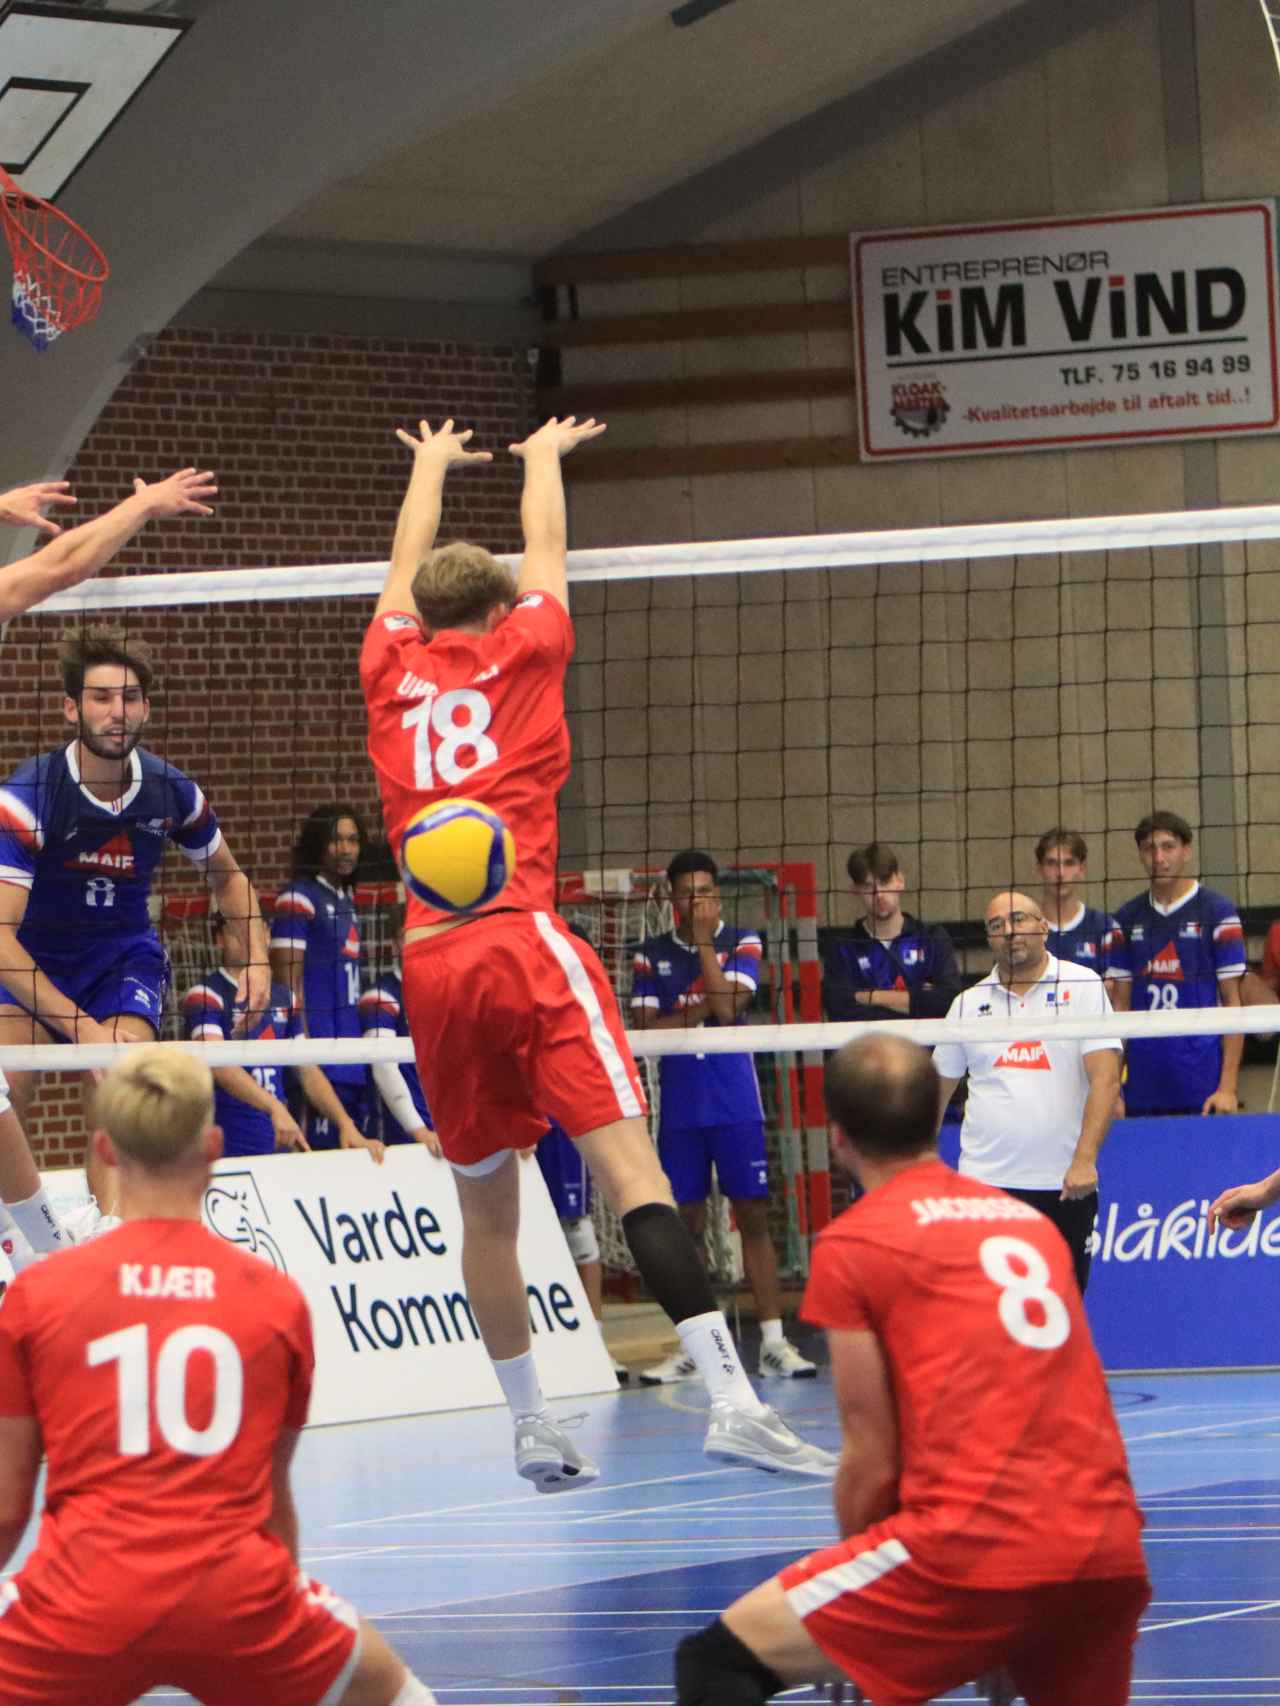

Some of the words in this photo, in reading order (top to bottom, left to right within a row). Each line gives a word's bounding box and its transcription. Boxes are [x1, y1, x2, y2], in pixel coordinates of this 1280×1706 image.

[882, 252, 1109, 287] ENTREPRENØR
[1060, 366, 1103, 386] TLF.
[1112, 363, 1140, 382] 75
[1149, 360, 1177, 379] 16
[1185, 357, 1213, 376] 94
[1222, 354, 1251, 374] 99
[1123, 395, 1141, 411] til
[1148, 391, 1200, 411] aftalt
[401, 688, 499, 790] 18
[79, 851, 135, 870] MAIF
[1146, 959, 1182, 974] MAIF
[1147, 983, 1179, 1010] 28
[1002, 1046, 1045, 1064] MAIF
[294, 1190, 449, 1265] Varde
[119, 1263, 216, 1300] KJÆR
[979, 1236, 1070, 1350] 8
[331, 1280, 580, 1353] Kommne
[86, 1322, 244, 1457] 10
